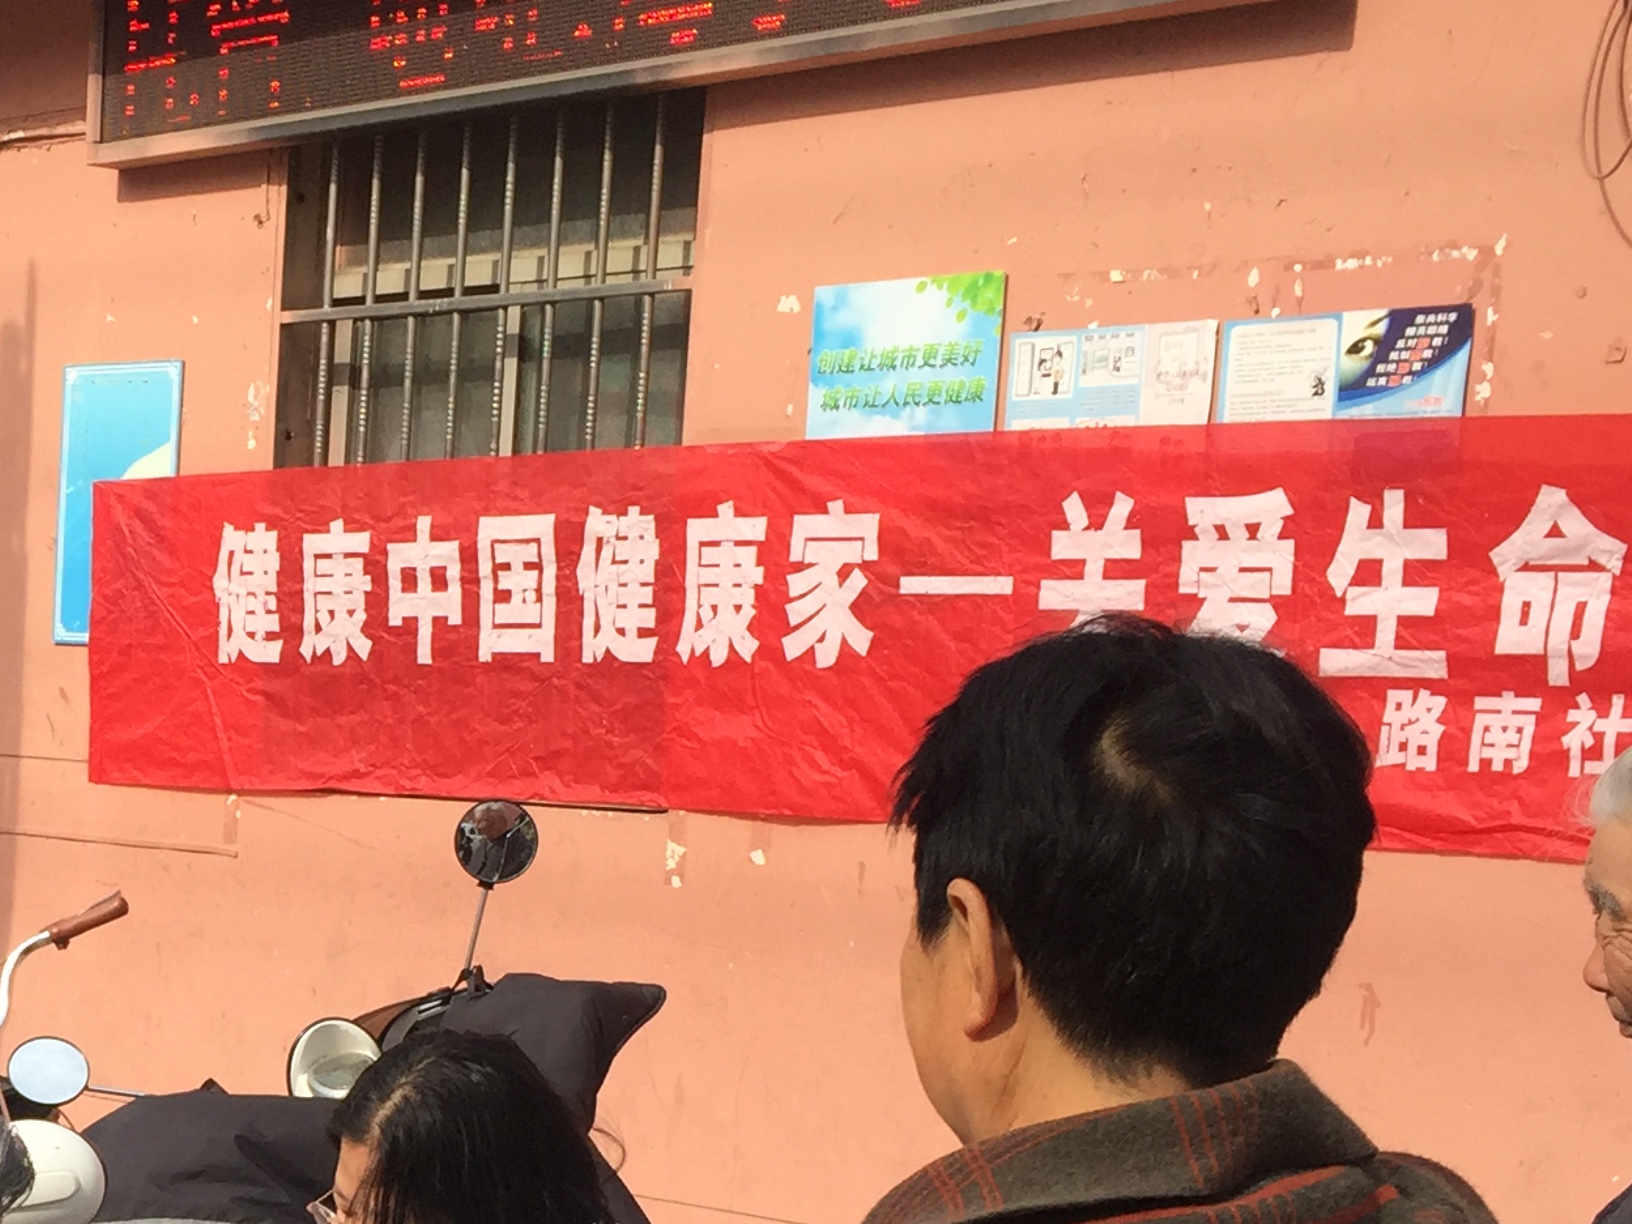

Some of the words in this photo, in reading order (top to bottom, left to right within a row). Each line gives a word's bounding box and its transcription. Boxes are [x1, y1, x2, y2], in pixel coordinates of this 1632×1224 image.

[817, 339, 984, 376] 创建让城市更美好
[820, 376, 987, 412] 城市让人民更健康
[1374, 689, 1632, 778] 路南社
